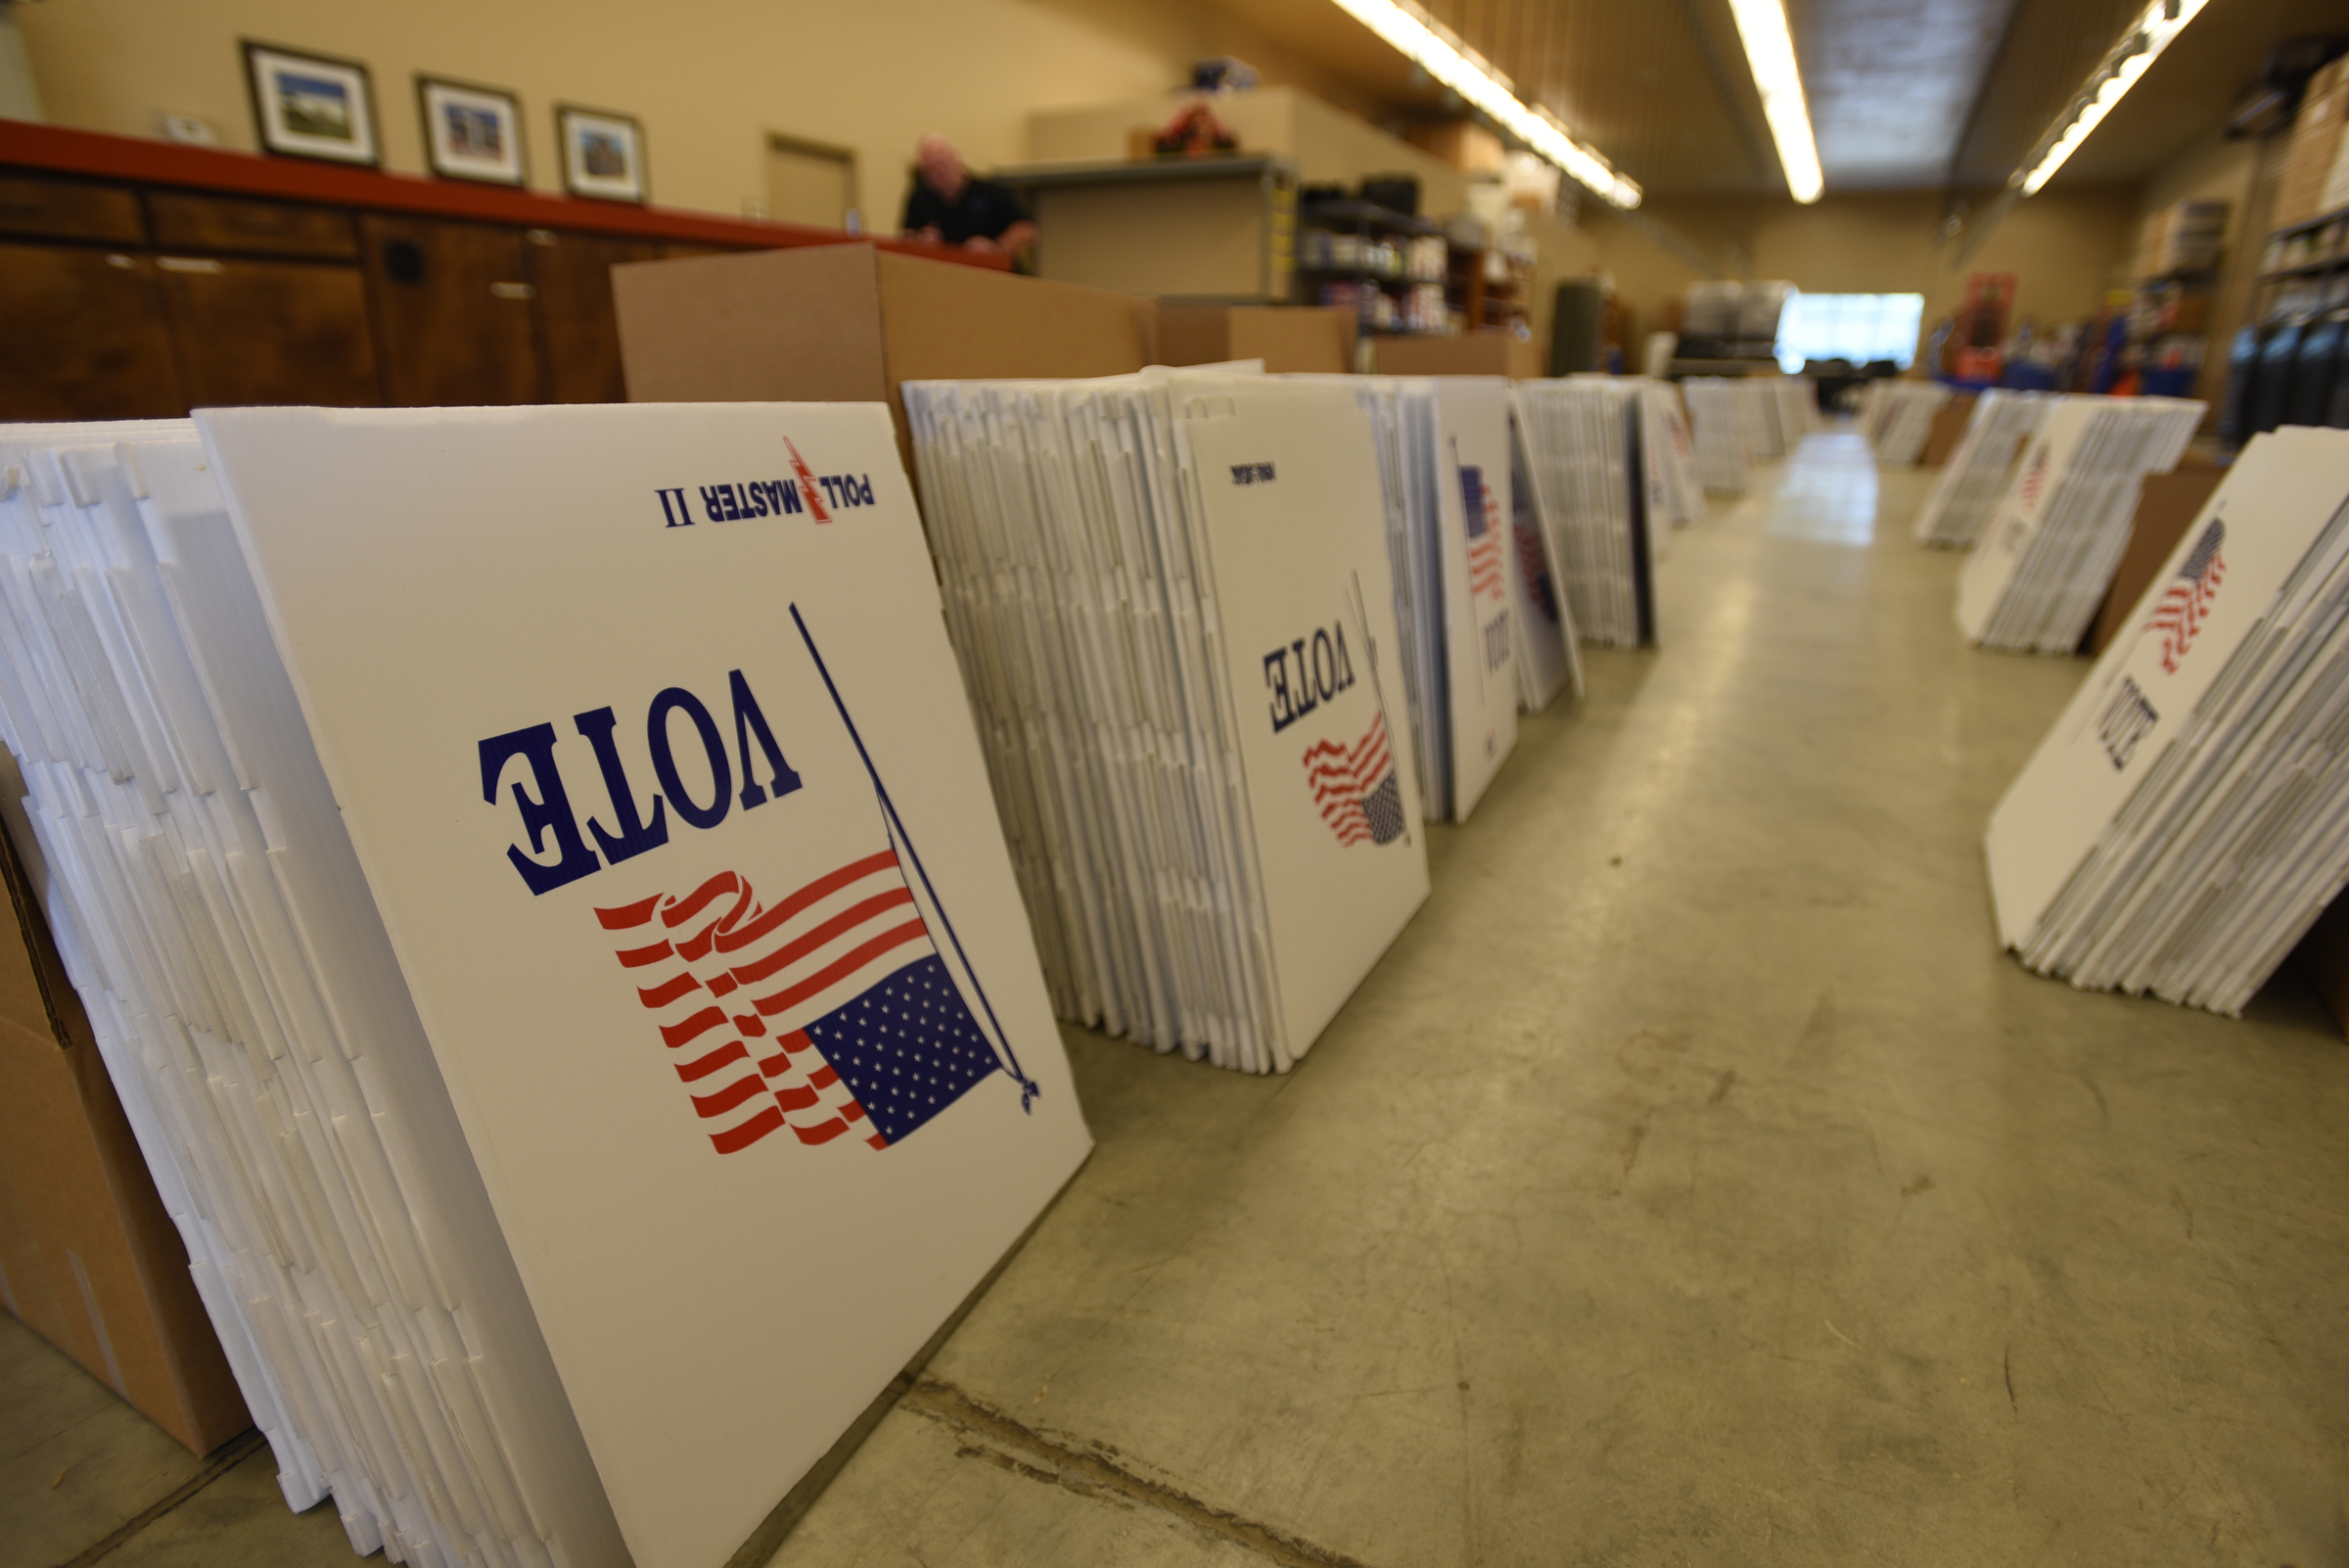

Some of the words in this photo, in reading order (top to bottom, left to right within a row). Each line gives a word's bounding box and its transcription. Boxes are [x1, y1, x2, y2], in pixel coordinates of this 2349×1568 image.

[654, 487, 695, 528] II
[699, 480, 803, 522] MASTER
[818, 473, 875, 508] POLL
[1263, 620, 1356, 733] VOTE
[478, 669, 803, 897] VOTE
